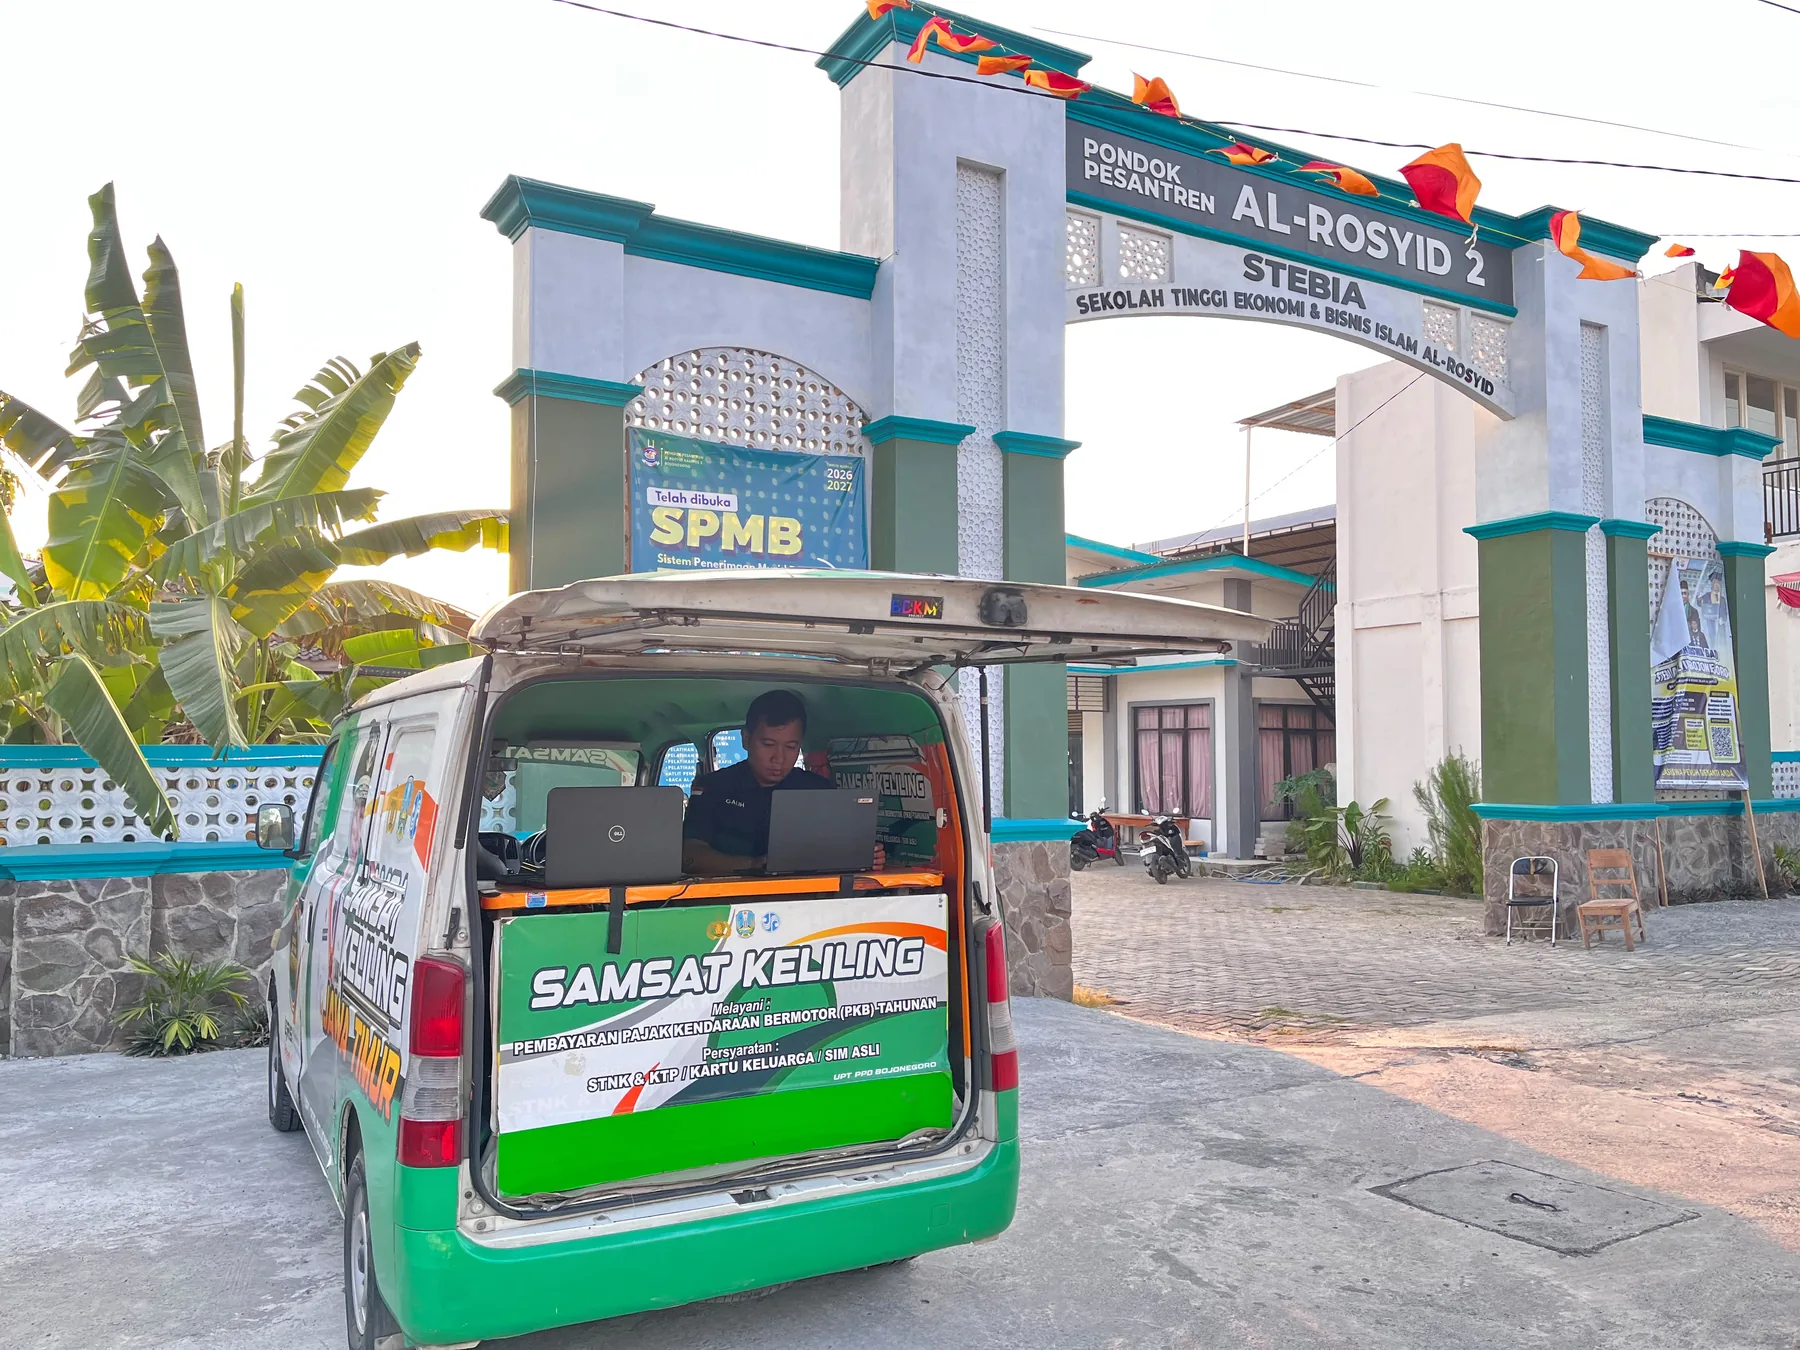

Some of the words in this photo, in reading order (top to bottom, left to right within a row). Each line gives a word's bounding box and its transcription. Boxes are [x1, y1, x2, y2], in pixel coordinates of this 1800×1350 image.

[1083, 138, 1181, 184] PONDOK
[1084, 164, 1215, 214] PESANTREN
[1232, 184, 1452, 276] AL-ROSYID
[1465, 249, 1486, 287] 2
[1243, 253, 1367, 309] STEBIA
[1076, 288, 1164, 314] SEKOLAH
[1171, 287, 1228, 308] TINGGI
[1234, 291, 1305, 318] EKONOMI
[1309, 302, 1321, 320] &
[1325, 307, 1372, 334] BISNIS
[1375, 322, 1418, 355] ISLAM
[1422, 346, 1495, 397] AL-ROSYID
[827, 469, 853, 480] 2026
[827, 480, 853, 492] 2027
[655, 490, 687, 504] Telah
[690, 494, 731, 508] dibuka
[650, 506, 803, 555] SPMB
[657, 553, 691, 566] Sistem
[879, 772, 926, 798] KELILING
[342, 924, 409, 1018] KELILING
[531, 951, 731, 1011] SAMSAT
[741, 938, 924, 988] KELILING
[513, 1031, 618, 1056] PEMBAYARAN
[622, 1022, 671, 1044] PAJAK
[673, 1015, 761, 1038] KENDARAAN
[764, 1008, 837, 1028] BERMOTOR
[712, 1001, 765, 1017] Melayani
[350, 1014, 401, 1122] TIMUR
[587, 1073, 632, 1093] STNK
[633, 1070, 646, 1086] &
[648, 1065, 679, 1085] KTP
[680, 1063, 688, 1081] /
[690, 1058, 739, 1079] KARTU
[742, 1051, 815, 1073] KELUARGA
[816, 1048, 822, 1064] /
[824, 1046, 848, 1062] SIM
[851, 1043, 880, 1058] ASLI
[702, 1041, 773, 1061] Persyaratan
[833, 1072, 852, 1081] UPT
[875, 1061, 937, 1076] BOJONEGORO
